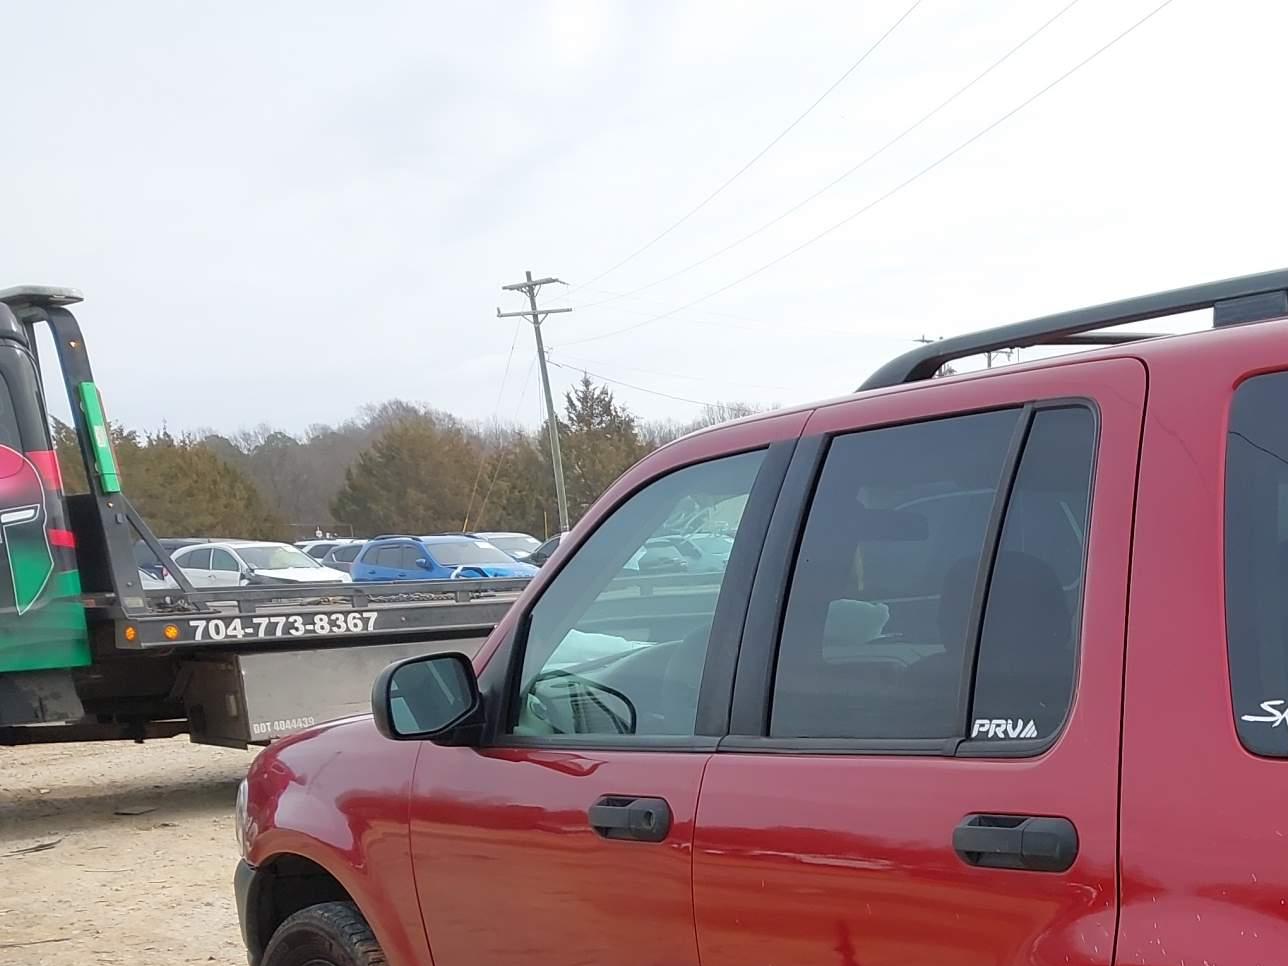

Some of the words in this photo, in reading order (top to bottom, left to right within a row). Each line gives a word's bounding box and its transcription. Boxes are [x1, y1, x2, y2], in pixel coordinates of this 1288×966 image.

[189, 612, 378, 641] 704-773-8367
[253, 722, 271, 735] DOT
[273, 716, 315, 732] 4044439
